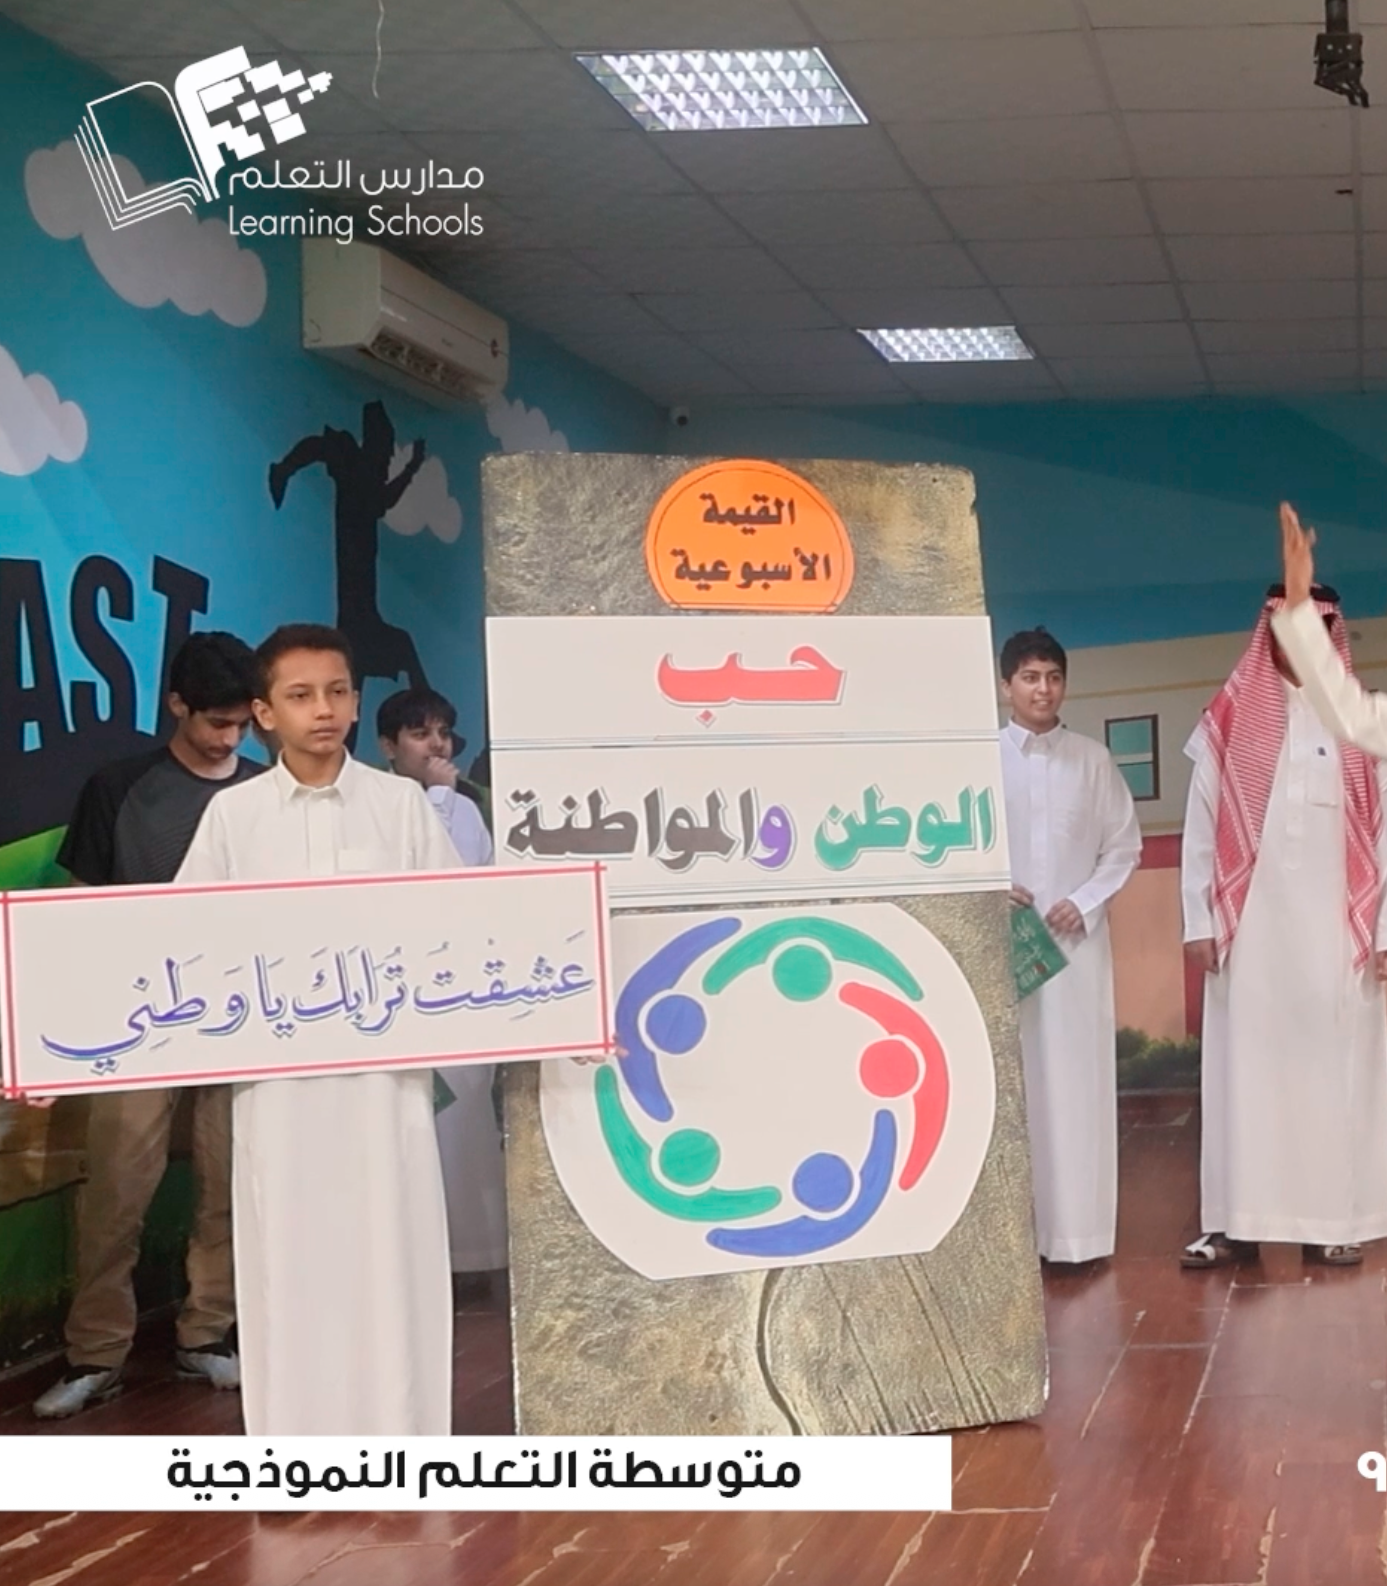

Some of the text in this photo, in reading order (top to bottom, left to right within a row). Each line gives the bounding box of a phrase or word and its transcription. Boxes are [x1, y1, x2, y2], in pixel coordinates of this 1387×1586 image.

[700, 494, 796, 535] القيمة
[671, 547, 832, 590] الأسبوعية
[655, 645, 846, 726] حب
[505, 784, 994, 873] الوطن والمواطنة
